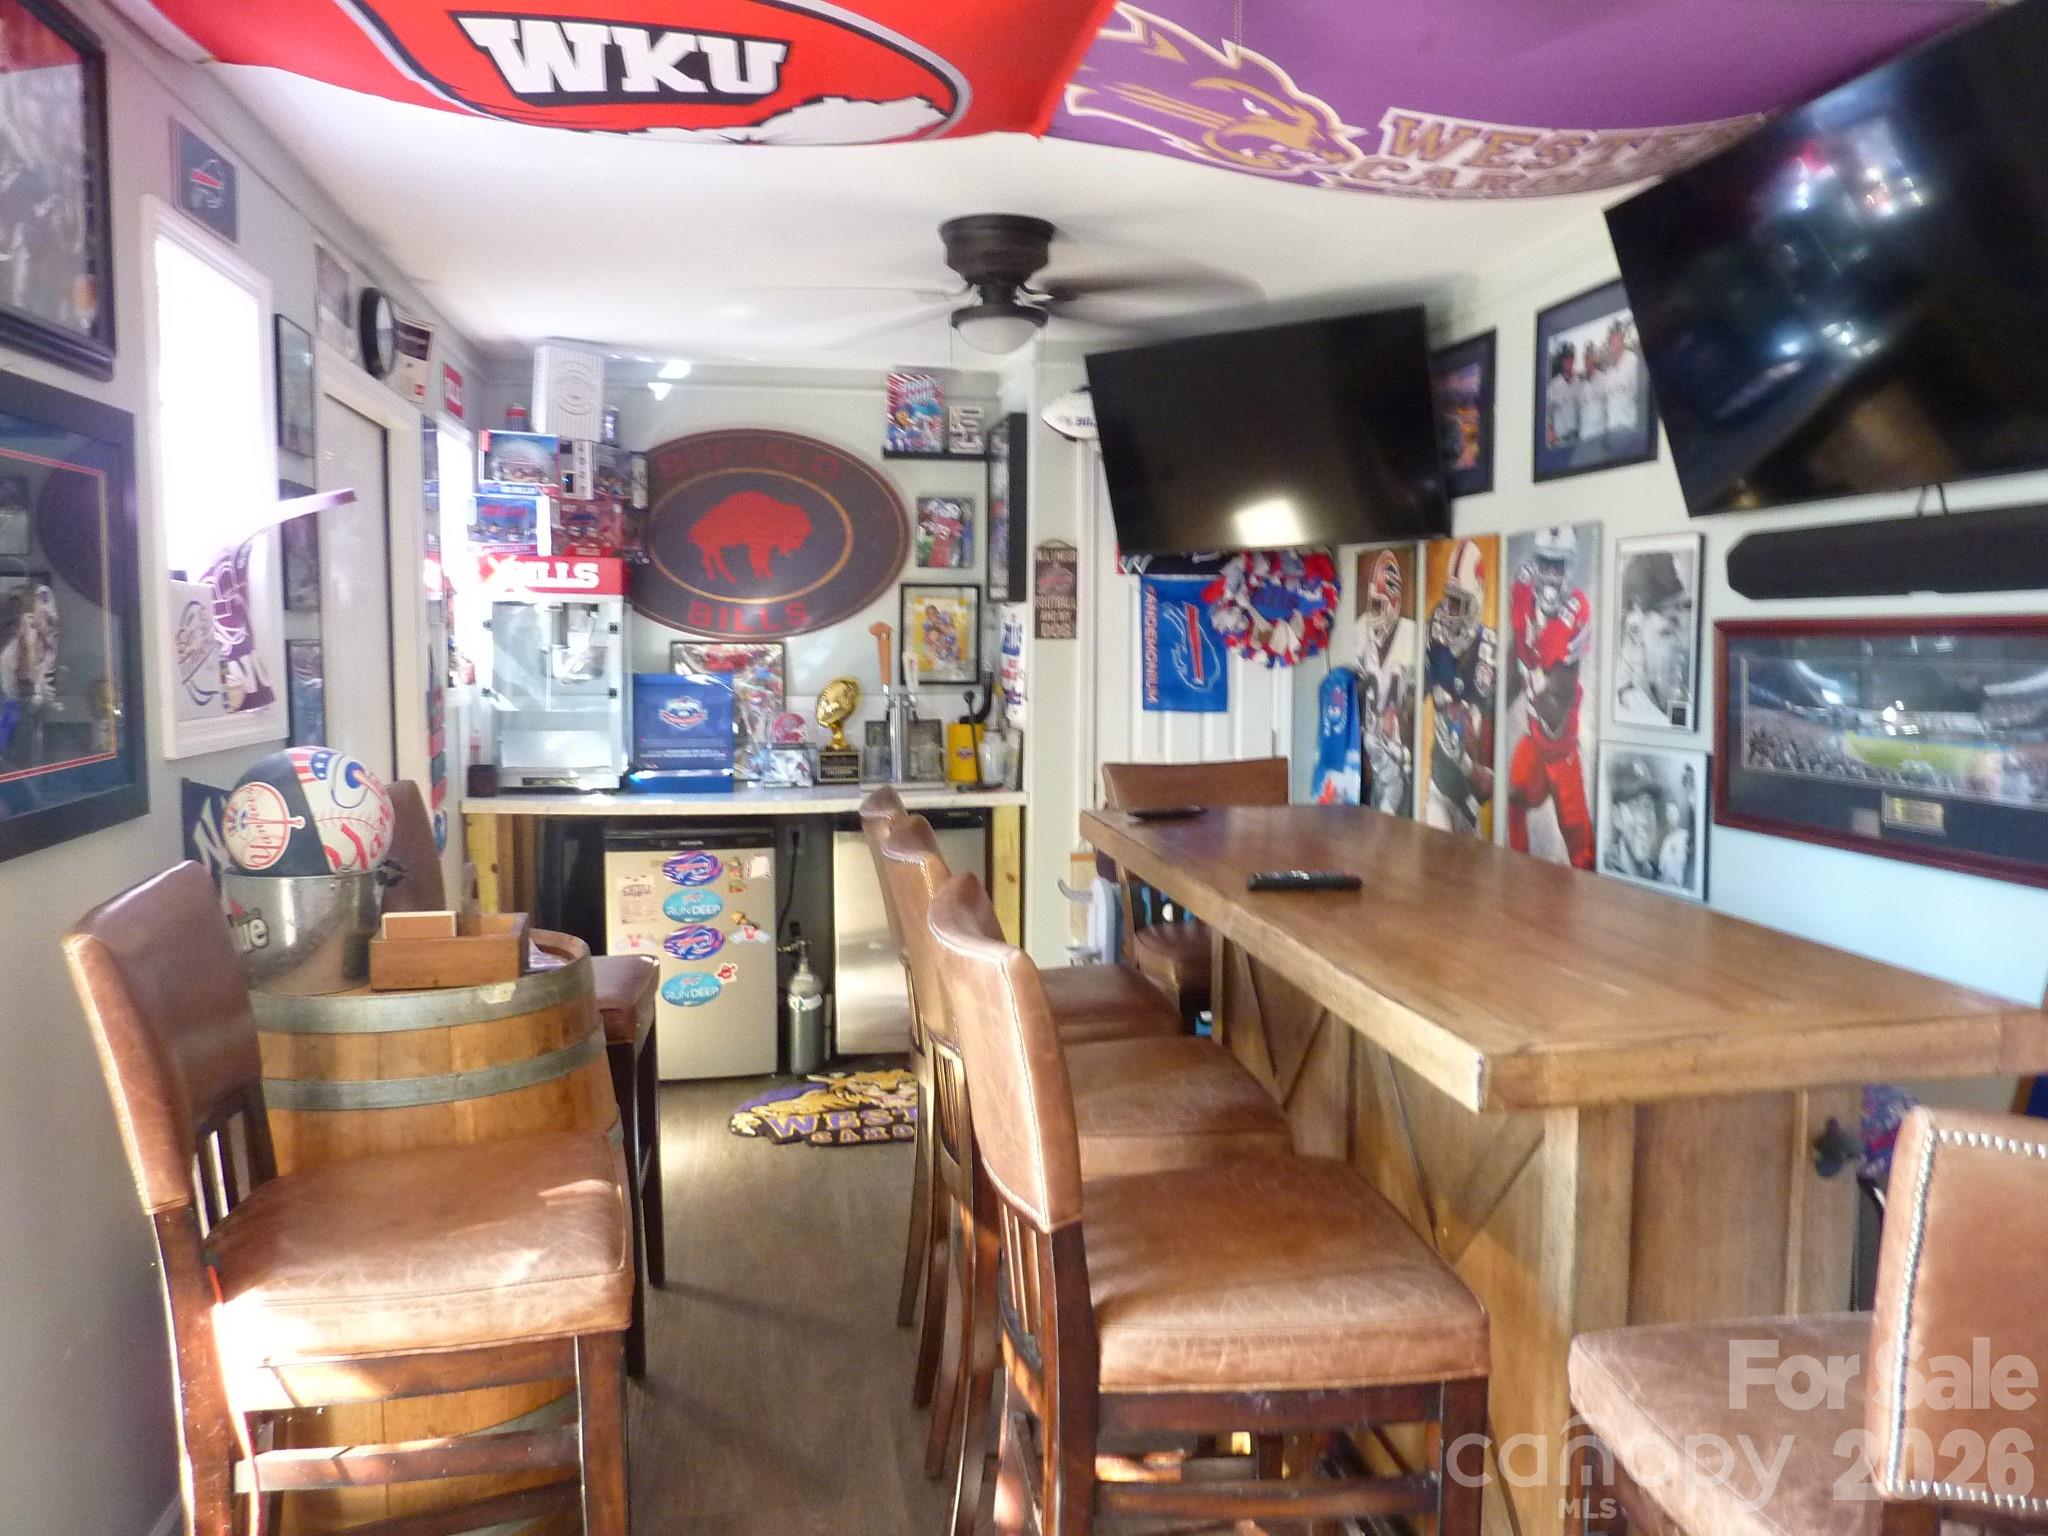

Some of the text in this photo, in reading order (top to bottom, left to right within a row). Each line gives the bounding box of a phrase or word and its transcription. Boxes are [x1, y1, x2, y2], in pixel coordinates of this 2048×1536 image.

[457, 15, 790, 95] WKU
[504, 561, 600, 589] ILLS
[687, 600, 808, 632] BILLS
[666, 903, 721, 917] RUN DEEP
[665, 986, 719, 1001] RUN DEEP
[762, 1106, 918, 1139] WEST
